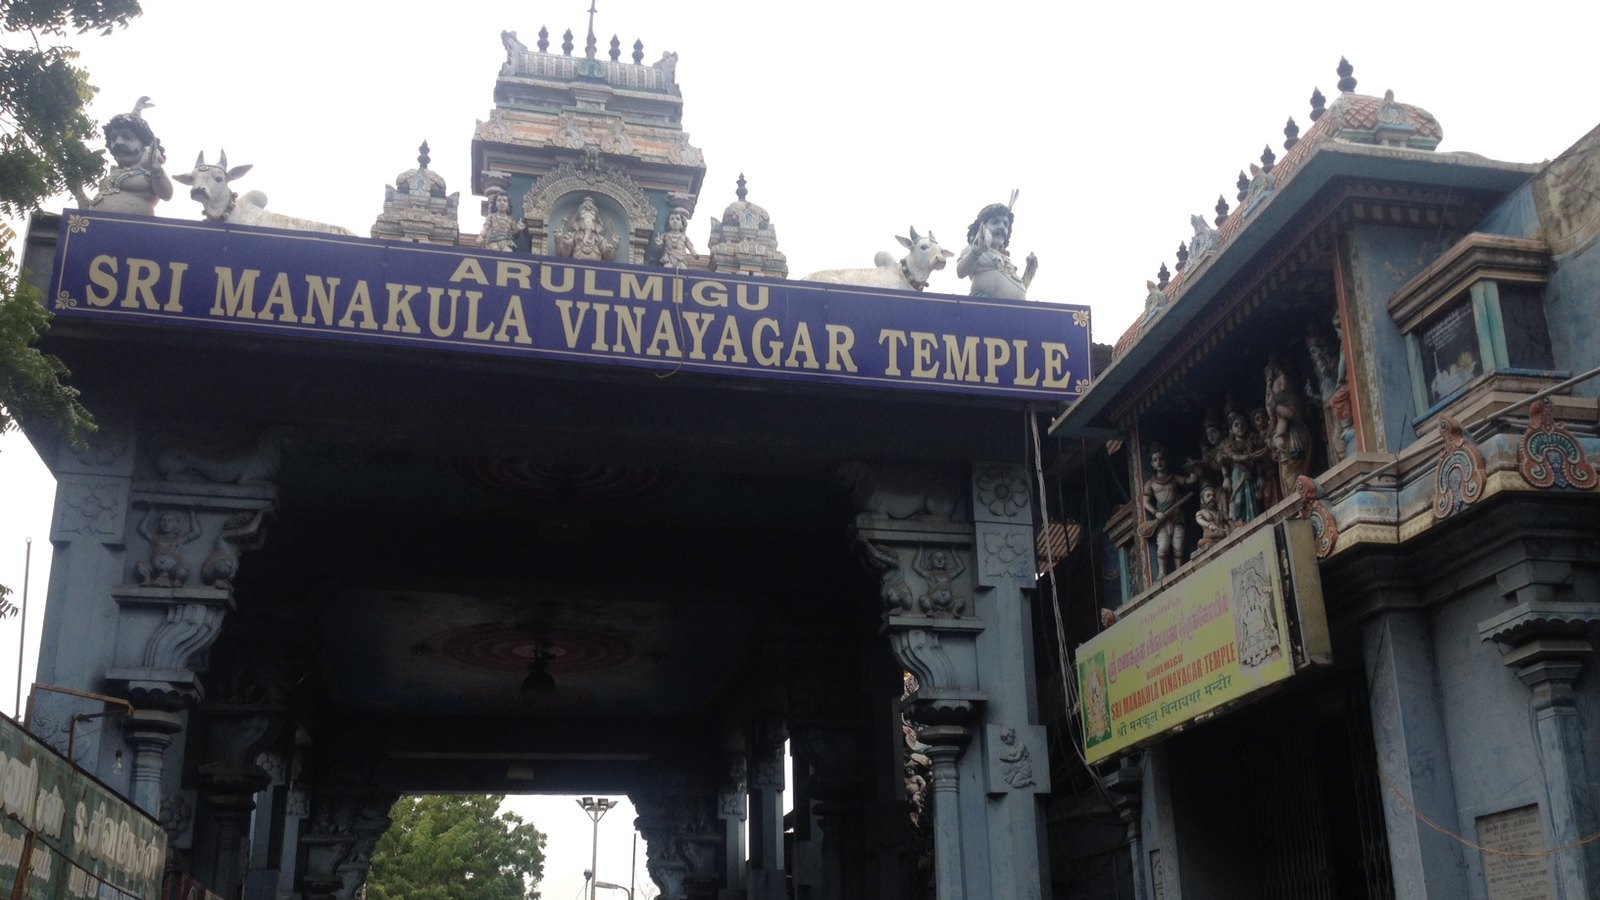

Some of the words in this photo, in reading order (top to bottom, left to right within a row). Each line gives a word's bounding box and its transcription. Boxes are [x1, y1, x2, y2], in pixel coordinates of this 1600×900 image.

[86, 254, 188, 313] SRI
[209, 265, 533, 345] MANAKULA
[555, 299, 858, 373] VINAYAGAR
[878, 328, 1073, 389] TEMPLE
[449, 257, 769, 311] ARULMIGU
[1111, 701, 1122, 720] SRI
[1123, 681, 1159, 715] MANAKULA
[1160, 658, 1203, 697] VINAYAGAR
[1204, 642, 1236, 674] TEMPLE
